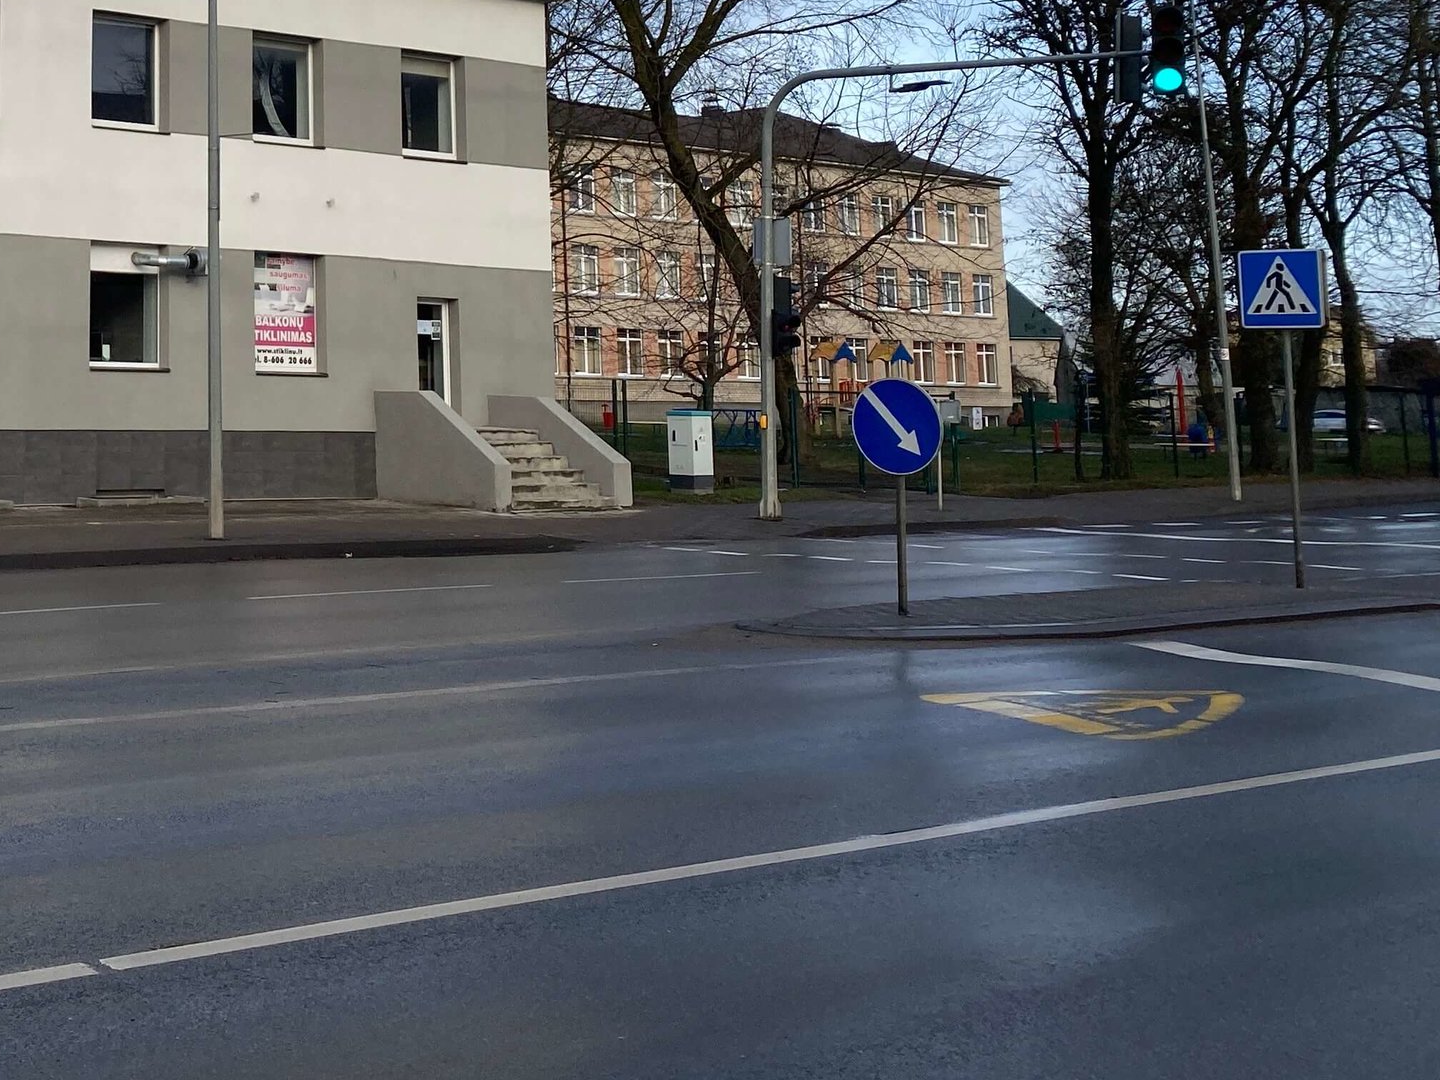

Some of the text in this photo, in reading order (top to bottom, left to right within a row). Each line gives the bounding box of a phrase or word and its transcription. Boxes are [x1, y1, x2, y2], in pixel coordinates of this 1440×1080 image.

[255, 315, 304, 331] BALKONŲ
[263, 355, 284, 364] 8-606
[288, 356, 298, 364] 20
[299, 357, 313, 365] 666
